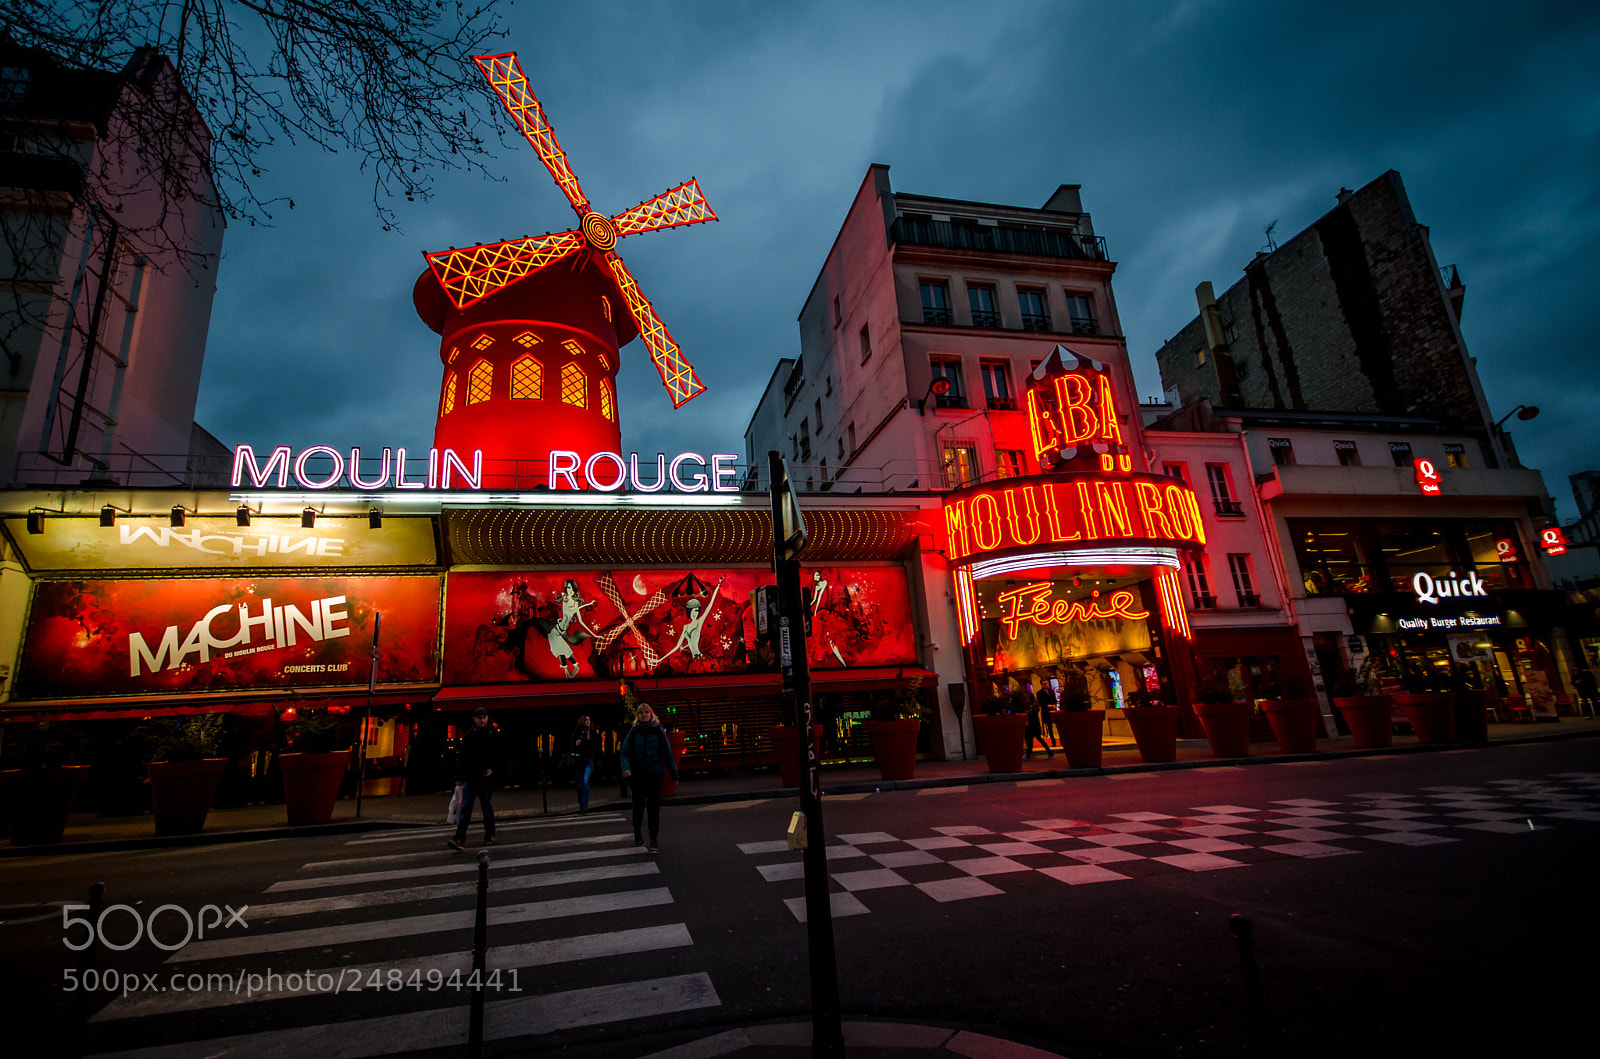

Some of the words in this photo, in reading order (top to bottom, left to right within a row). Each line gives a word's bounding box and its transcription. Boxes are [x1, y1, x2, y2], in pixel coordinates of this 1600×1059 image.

[1268, 439, 1290, 447] Quick
[1334, 441, 1355, 449] Quick
[1390, 443, 1410, 451] Quick
[230, 444, 482, 489] MOULIN
[548, 450, 740, 492] ROUGE
[1102, 454, 1131, 471] DU
[1420, 461, 1437, 479] Q
[945, 482, 1134, 560] MOULIN
[1543, 531, 1559, 544] Q
[1413, 571, 1488, 604] Quick
[999, 581, 1150, 640] Féerie
[1399, 618, 1428, 630] Quality
[1430, 617, 1458, 629] Burger
[1460, 616, 1501, 627] Restaurant
[129, 595, 350, 677] MACHINE
[224, 651, 233, 659] DU
[234, 648, 256, 657] MOULIN
[256, 644, 275, 652] ROUGE
[284, 664, 326, 673] CONCERTS
[327, 663, 348, 672] CLUB
